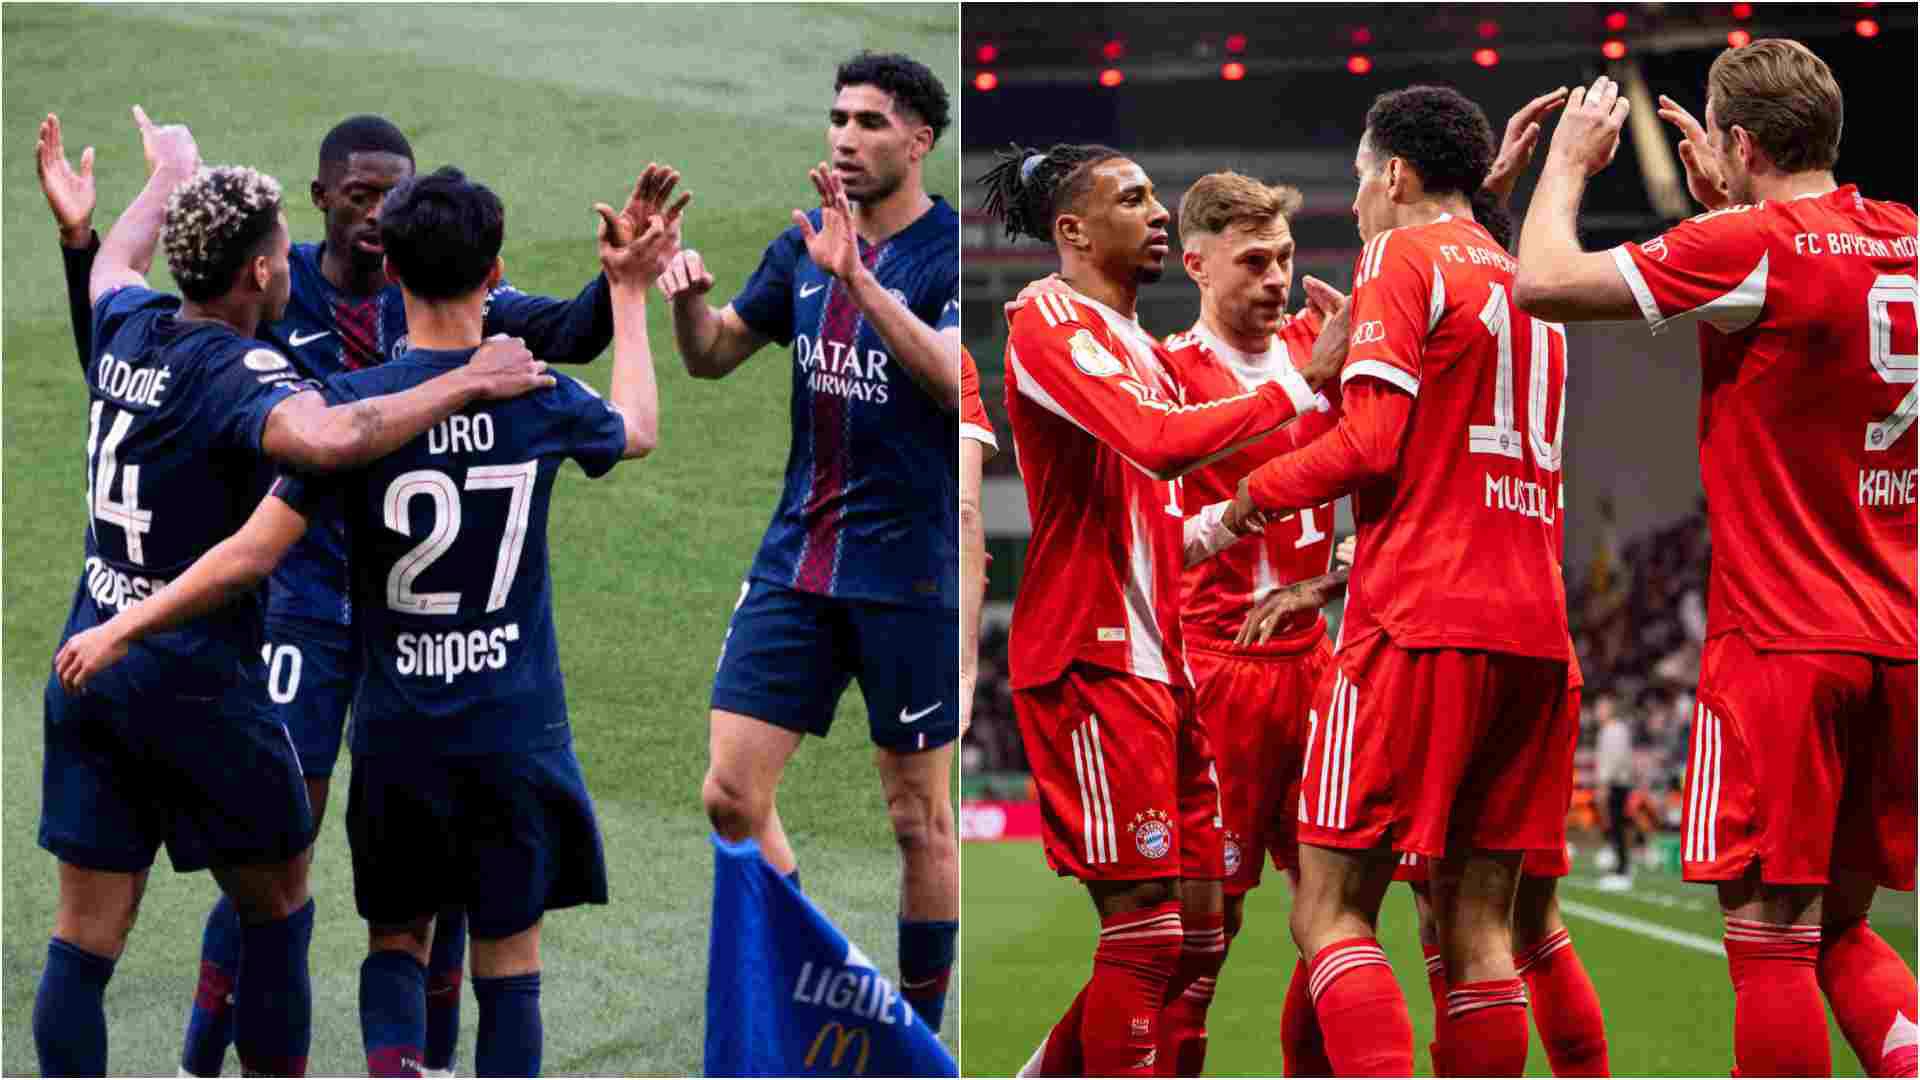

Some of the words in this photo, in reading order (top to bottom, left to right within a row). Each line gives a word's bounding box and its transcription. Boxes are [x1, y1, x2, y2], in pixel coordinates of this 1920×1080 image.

[1440, 244, 1465, 263] FC
[1795, 232, 1823, 255] FC
[1827, 233, 1888, 257] BAYERN
[797, 333, 889, 382] QATAR
[1468, 280, 1568, 472] 10
[807, 371, 889, 404] AIRWAYS
[428, 413, 495, 454] DRO
[86, 400, 152, 566] 14
[1858, 468, 1918, 506] KANE
[384, 459, 538, 615] 27
[396, 625, 508, 684] snipes
